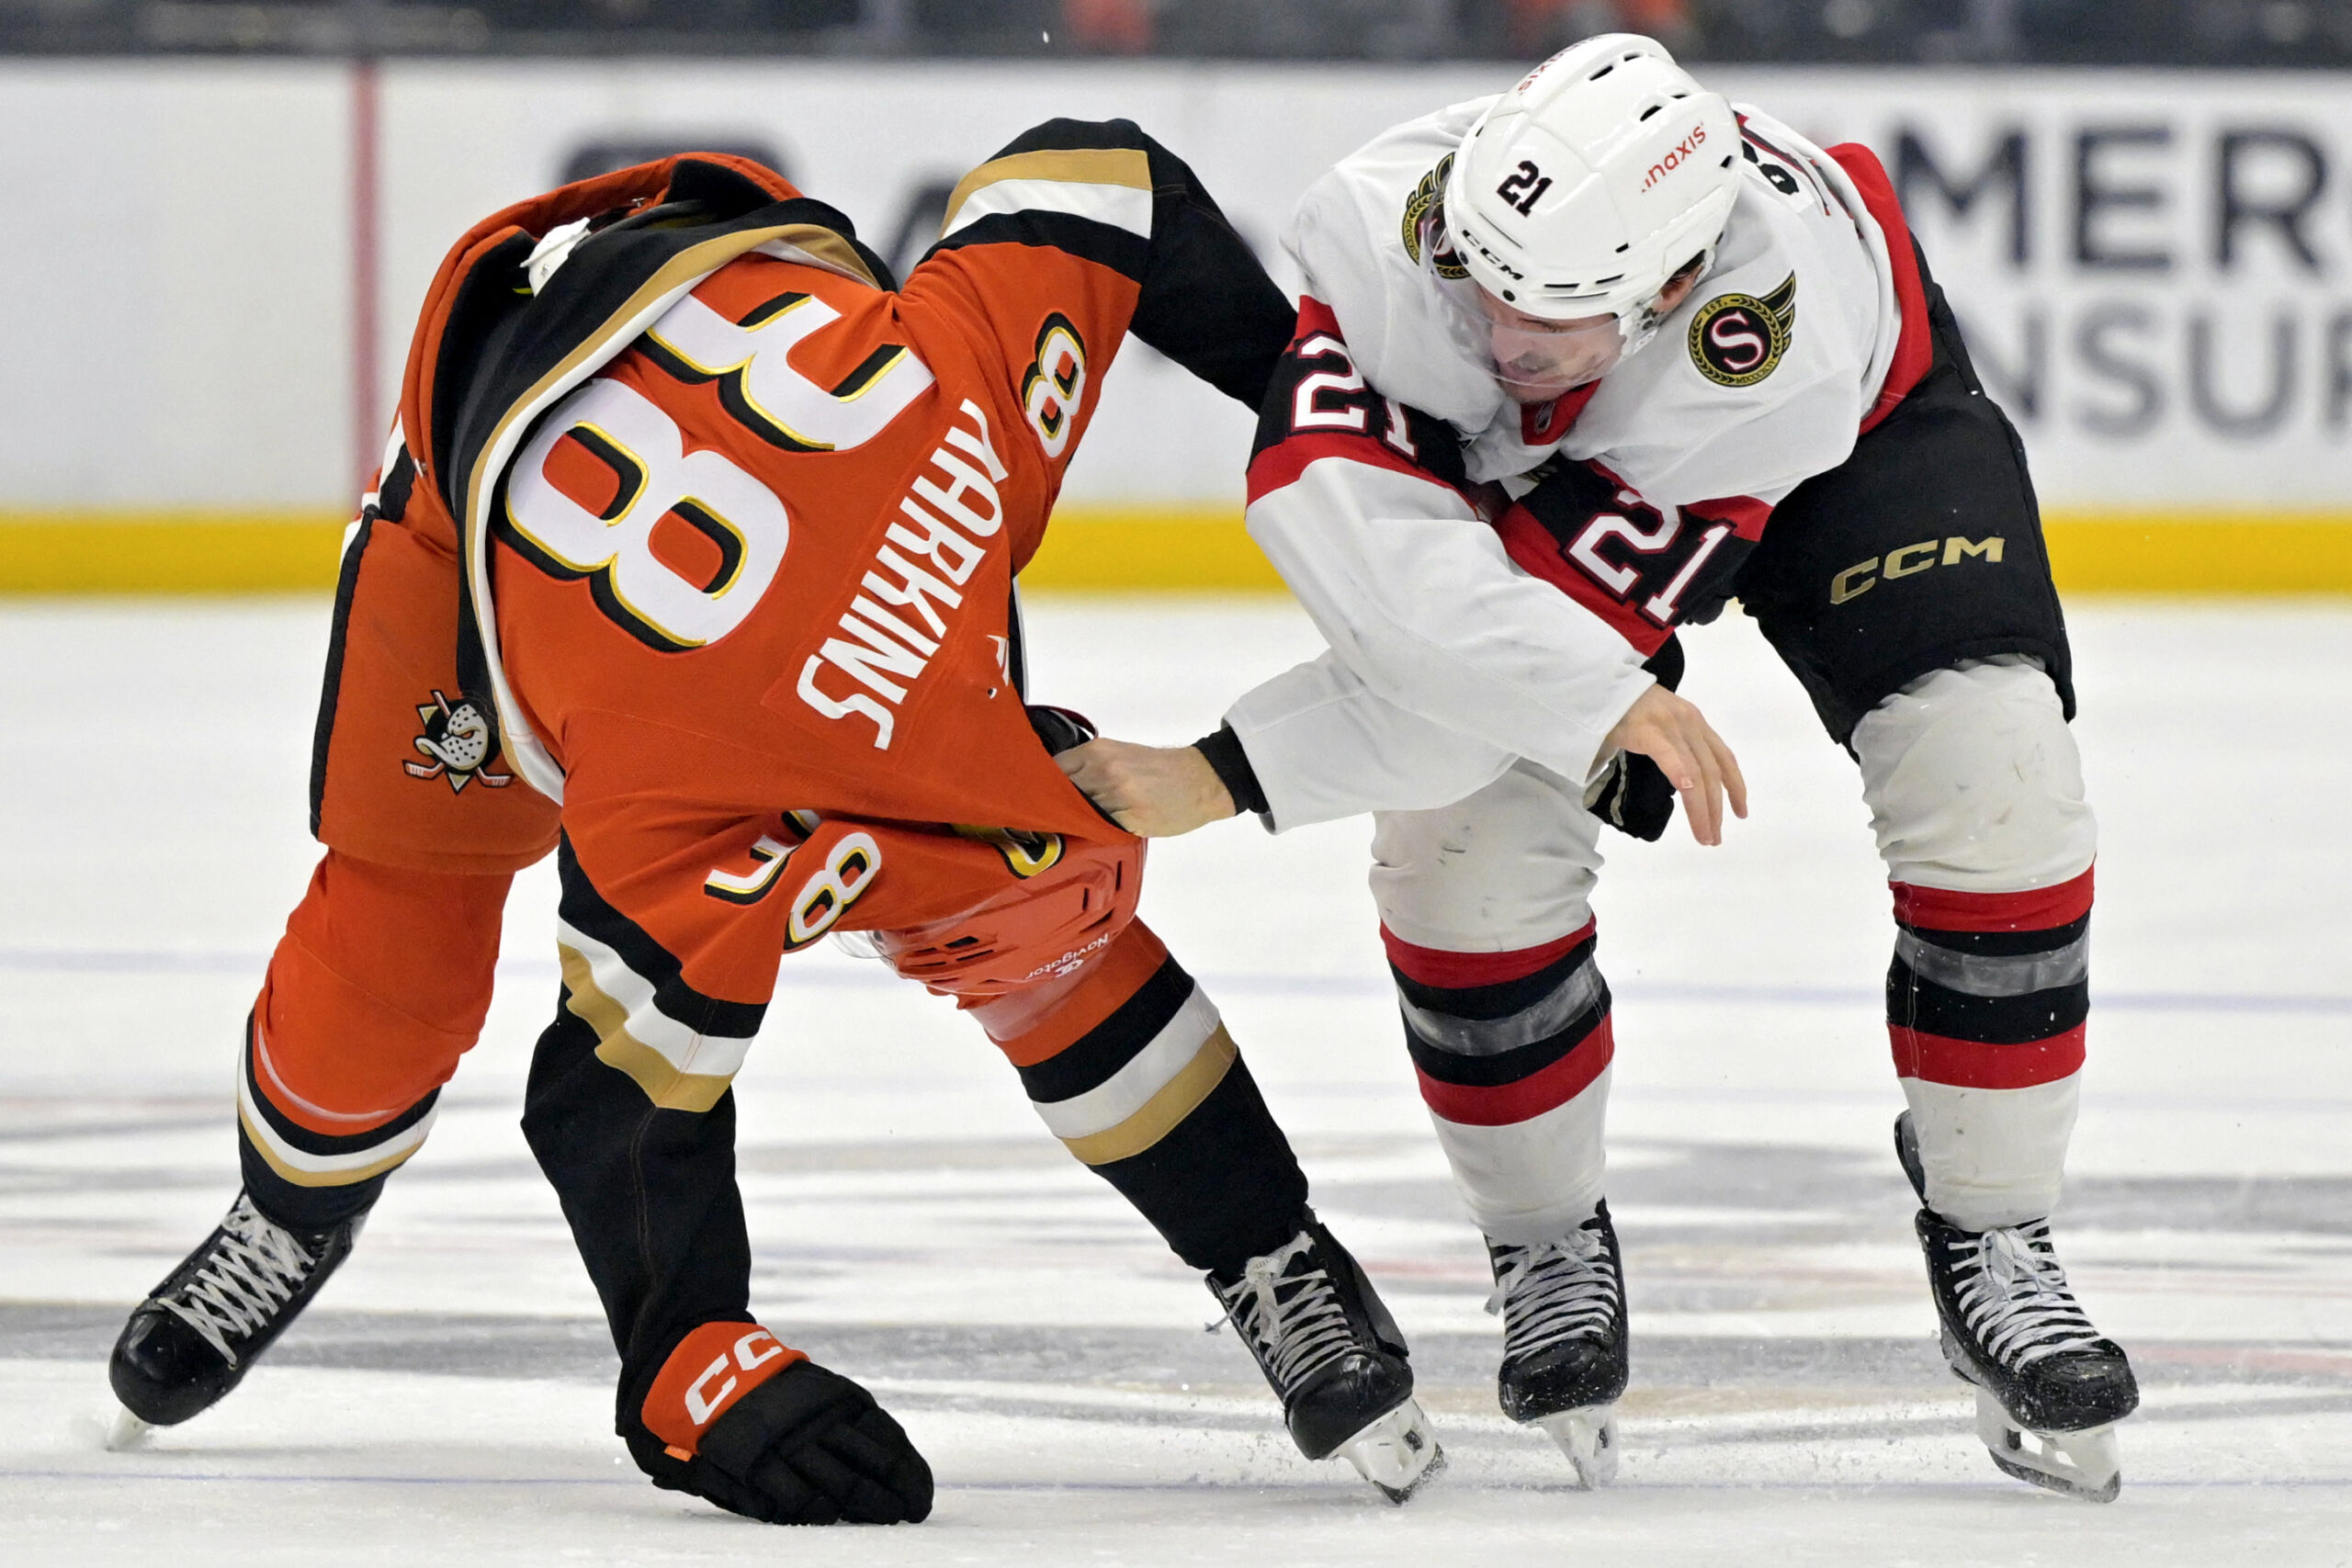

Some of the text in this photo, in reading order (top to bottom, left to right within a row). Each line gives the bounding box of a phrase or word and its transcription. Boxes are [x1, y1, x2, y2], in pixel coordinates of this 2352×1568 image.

[1497, 159, 1553, 217] 21
[1463, 229, 1524, 280] CCM
[1711, 310, 1763, 371] S
[1290, 330, 1419, 463] 21
[1564, 489, 1736, 628] 21
[1830, 536, 2007, 604] CCM
[1024, 932, 1110, 980] Navigator
